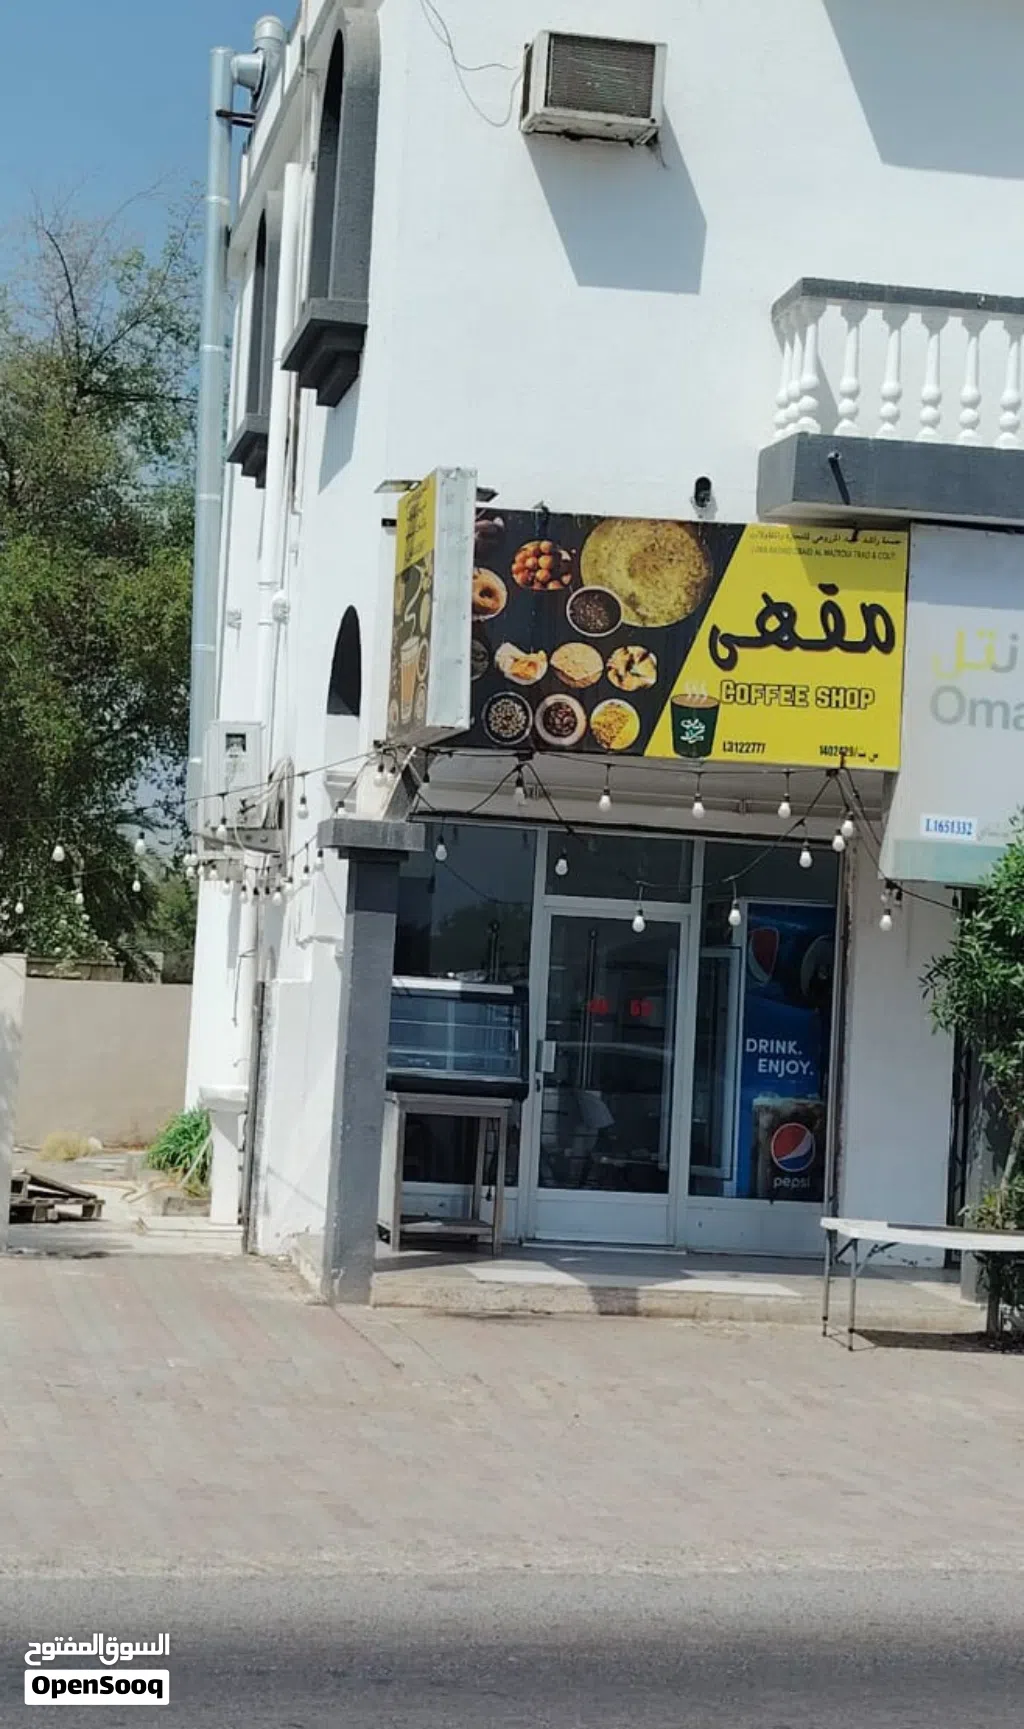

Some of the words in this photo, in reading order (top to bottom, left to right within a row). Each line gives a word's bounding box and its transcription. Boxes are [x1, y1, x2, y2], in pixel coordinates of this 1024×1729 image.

[720, 680, 810, 707] COFFEE
[815, 687, 875, 710] SHOP
[745, 1038, 803, 1055] DRINK.
[757, 1058, 815, 1078] ENJOY.
[772, 1175, 811, 1190] pepsi
